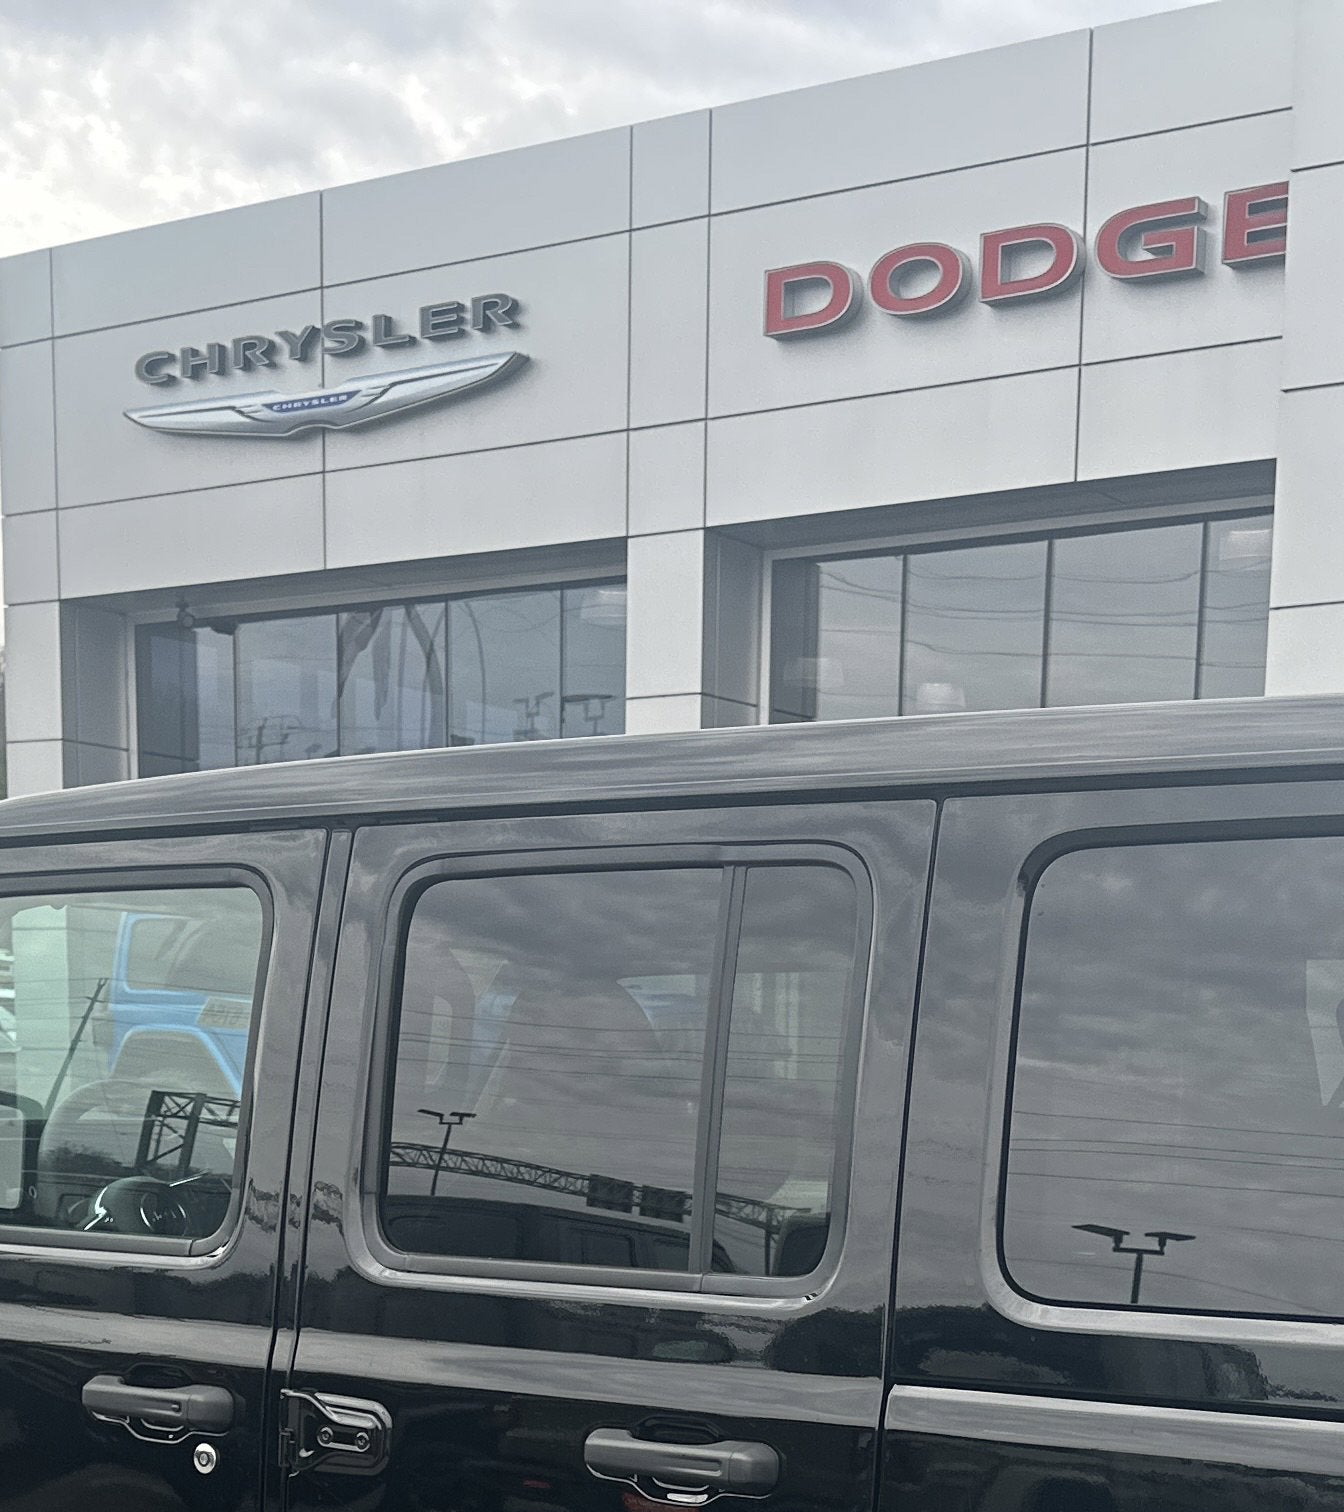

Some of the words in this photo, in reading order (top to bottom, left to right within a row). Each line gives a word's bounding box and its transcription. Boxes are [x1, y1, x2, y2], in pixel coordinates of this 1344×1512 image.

[763, 180, 1289, 339] DODGE
[134, 292, 521, 386] CHRYSLER
[272, 394, 348, 412] CHRYSLER
